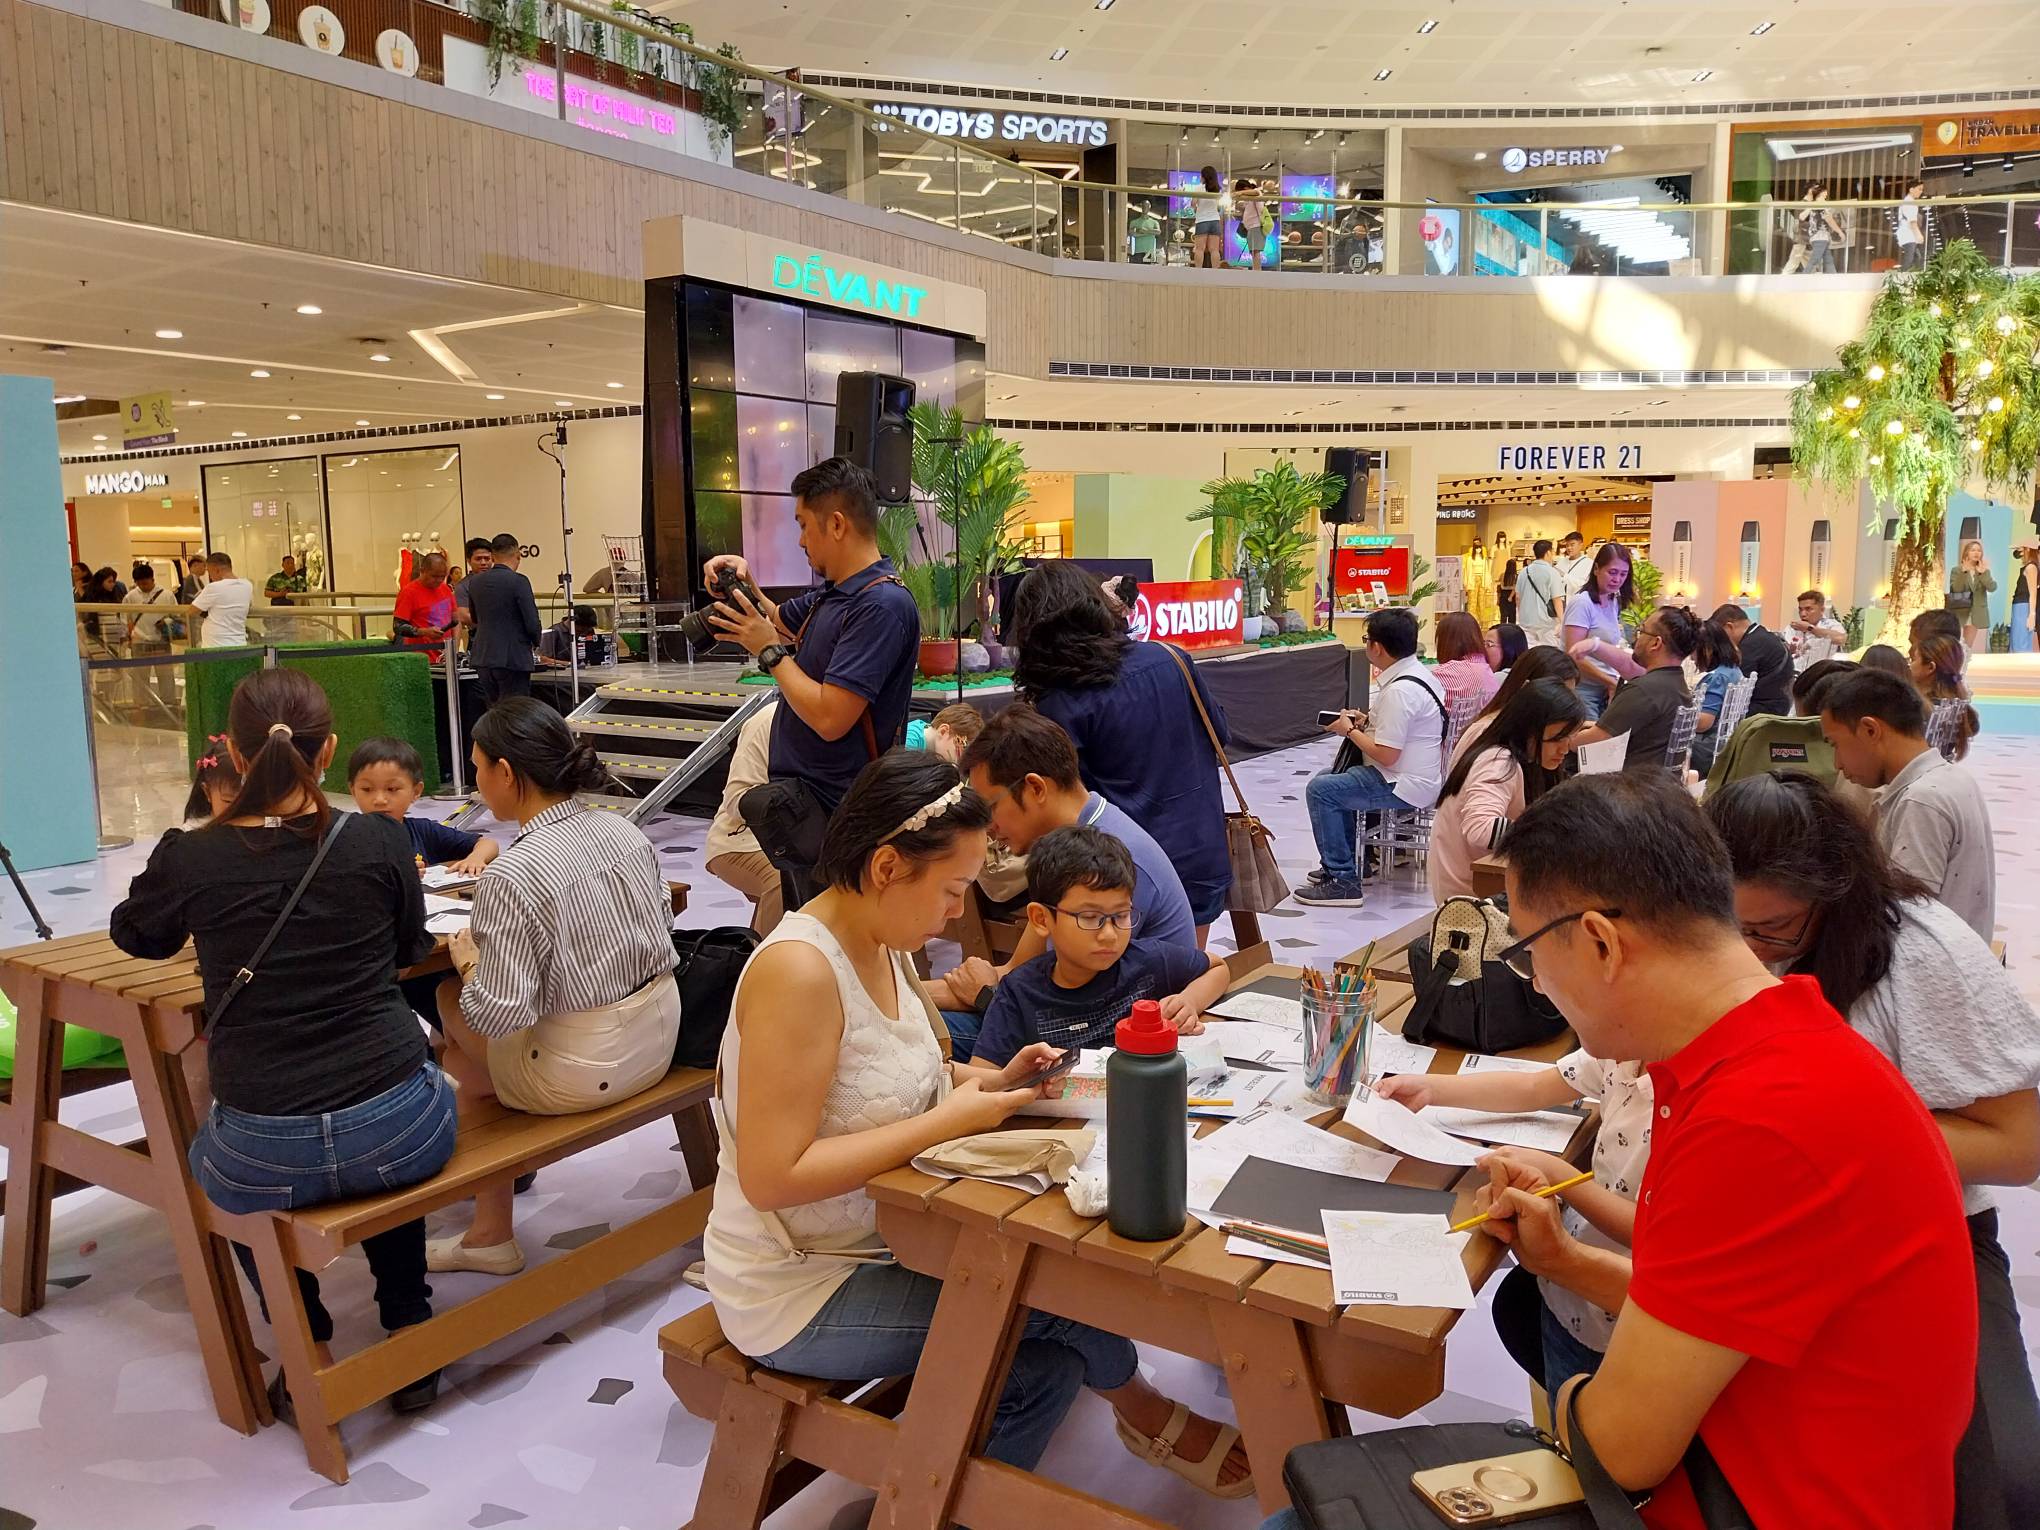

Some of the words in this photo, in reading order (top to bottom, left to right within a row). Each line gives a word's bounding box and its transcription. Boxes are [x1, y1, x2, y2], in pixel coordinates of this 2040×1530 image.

[526, 72, 555, 101] THE
[591, 93, 609, 115] OF
[612, 100, 645, 127] MILK
[649, 110, 675, 135] TEA
[900, 107, 995, 140] TOBYS
[1001, 114, 1108, 147] SPORTS
[1966, 124, 2040, 138] TRAVELLE
[1528, 149, 1609, 168] SPERRY
[773, 254, 928, 318] DÉVANT
[1500, 446, 1606, 470] FOREVER
[1618, 445, 1641, 469] 21
[85, 470, 145, 496] MANGO
[144, 473, 167, 487] MAN
[1437, 510, 1450, 519] PING
[519, 544, 540, 558] GO
[1155, 598, 1239, 637] STABILO
